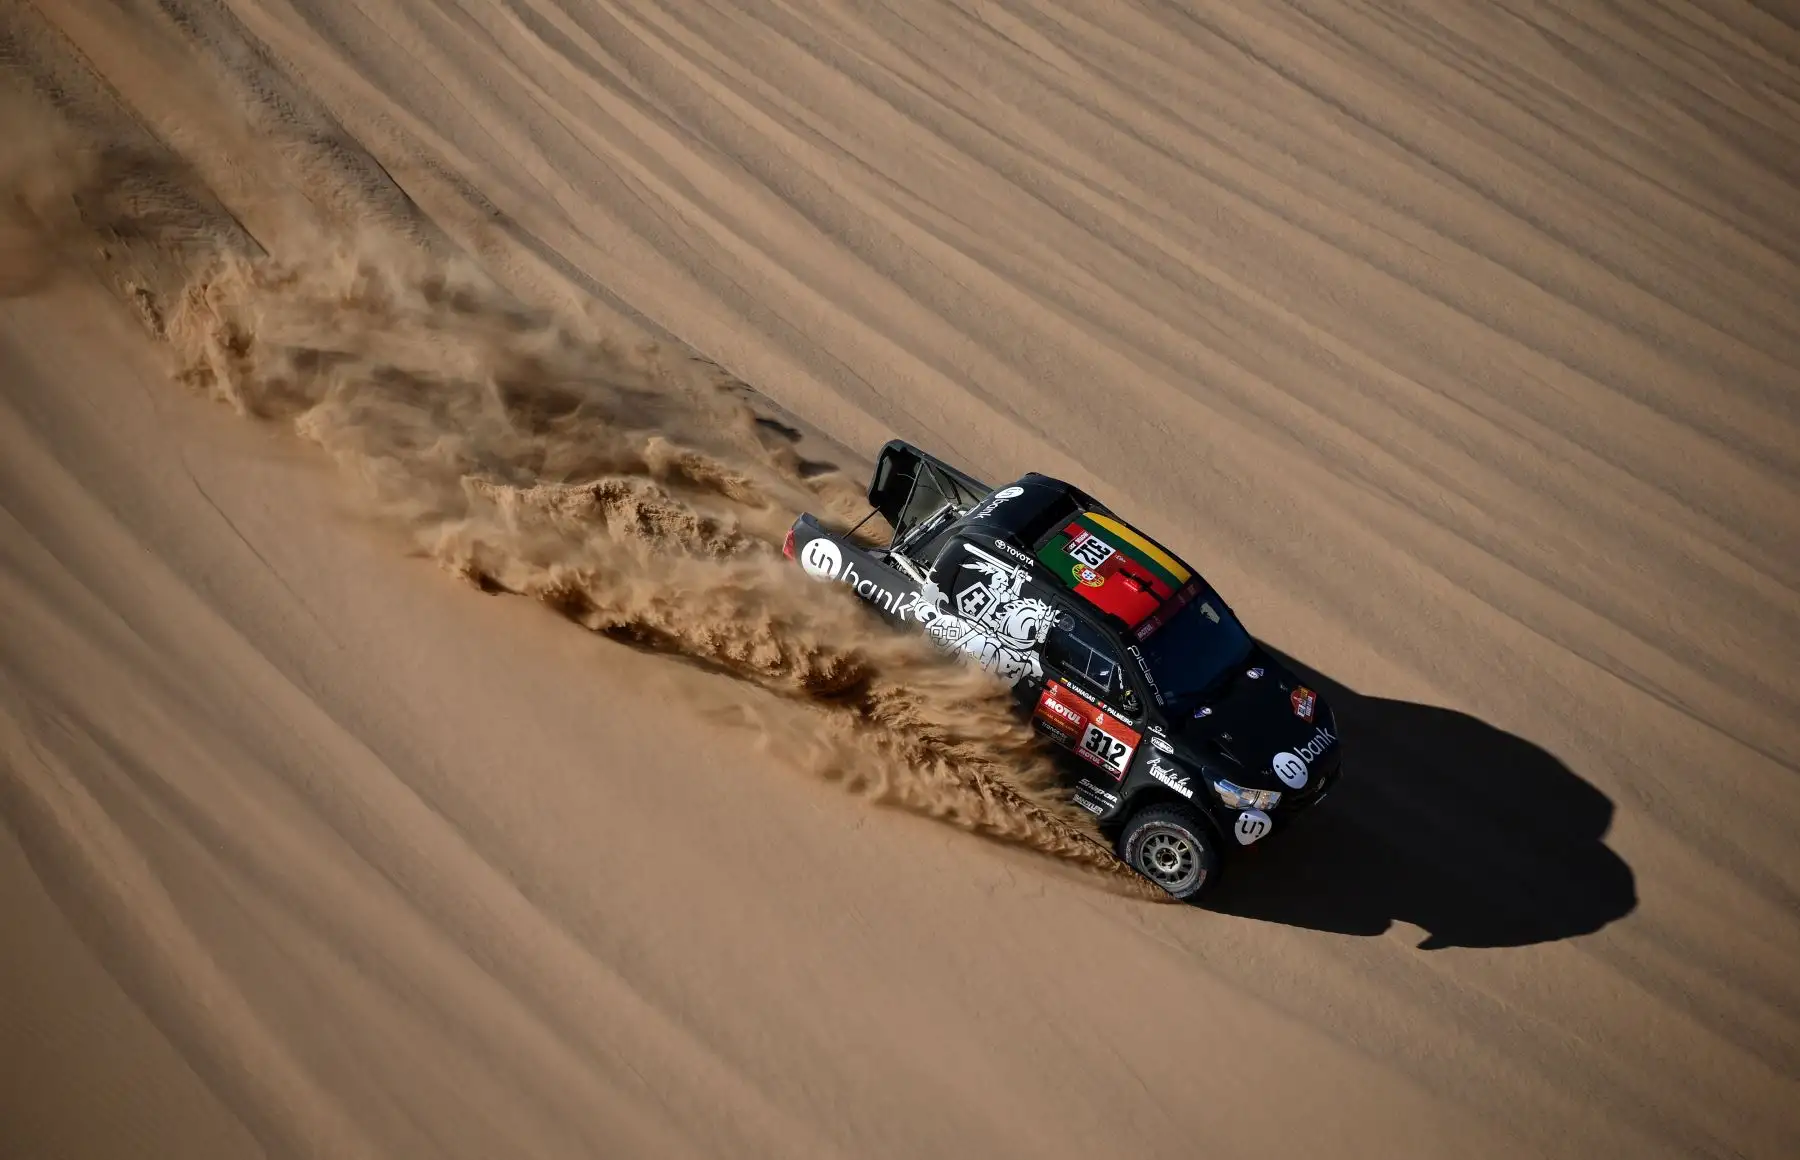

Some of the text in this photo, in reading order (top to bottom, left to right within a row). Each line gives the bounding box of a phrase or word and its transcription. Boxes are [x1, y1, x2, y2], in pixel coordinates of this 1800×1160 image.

[810, 542, 834, 578] in
[1006, 545, 1035, 567] TOYOTA
[1074, 538, 1111, 566] 312
[1127, 645, 1164, 706] pitlane
[1044, 697, 1081, 725] MOTUL
[1079, 748, 1101, 765] MOTUL
[1086, 728, 1126, 767] 312
[1294, 727, 1336, 764] bank
[1149, 766, 1194, 799] LITHUANIAN
